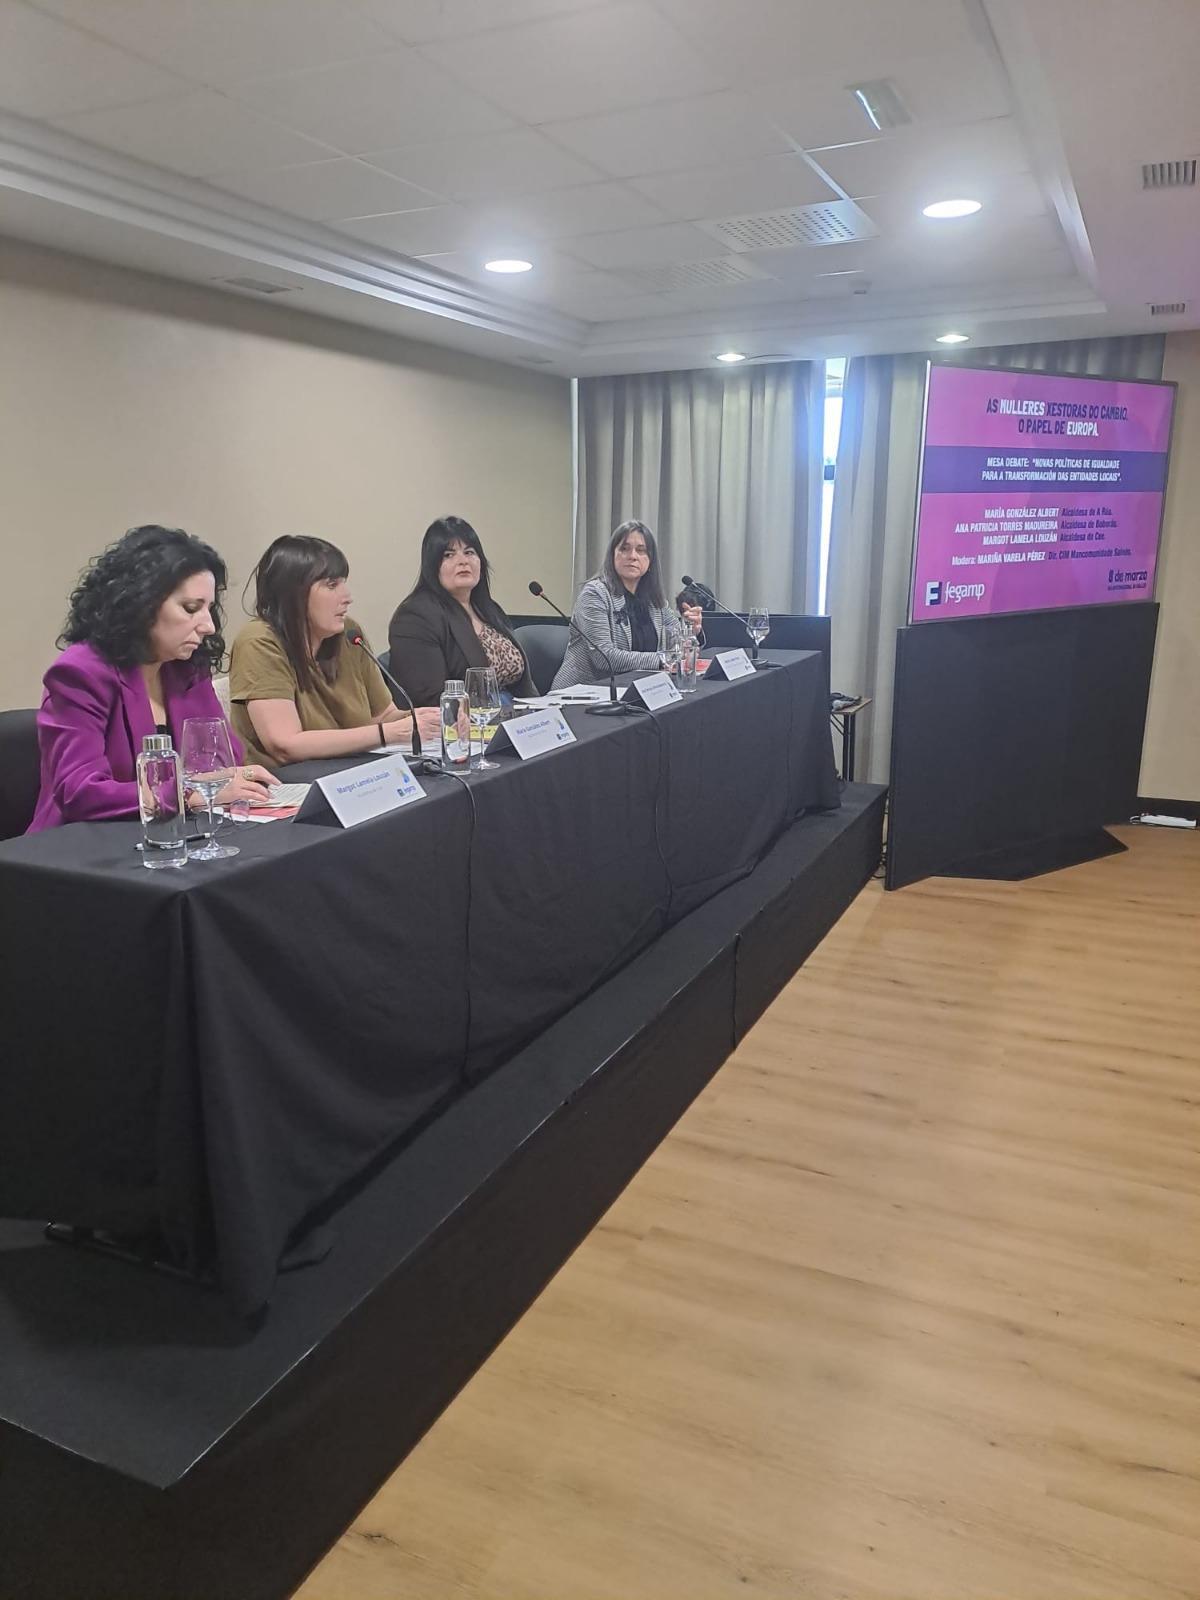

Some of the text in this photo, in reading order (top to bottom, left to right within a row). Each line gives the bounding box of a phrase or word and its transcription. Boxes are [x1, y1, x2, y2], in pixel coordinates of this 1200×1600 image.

[986, 398, 998, 413] AS
[1000, 399, 1045, 416] MULLERES
[1046, 402, 1087, 418] XESTORAS
[1089, 406, 1099, 420] DO
[1018, 418, 1024, 433] O
[1026, 419, 1052, 434] PAPEL
[1054, 421, 1065, 434] DE
[987, 458, 1004, 467] MESA
[1006, 458, 1029, 468] DEBATE:
[1054, 458, 1082, 468] POLÍTICAS
[1083, 460, 1090, 468] DE
[1091, 460, 1120, 469] IGUALDADE
[982, 471, 997, 480] PARA
[999, 471, 1003, 480] A
[1005, 470, 1056, 481] TRANSFORMACIÓN
[1058, 472, 1068, 481] DAS
[1070, 472, 1098, 481] ENTIDADES
[984, 506, 1005, 518] MARÍA
[1006, 506, 1036, 518] GONZÁLEZ
[1037, 508, 1059, 517] ALBERT
[955, 523, 968, 533] ANA
[970, 522, 998, 532] PATRICIA
[1000, 522, 1023, 531] TORRES
[983, 535, 1010, 545] MARGOT
[1010, 534, 1033, 544] LAMELA
[1035, 532, 1058, 543] LOUZÁN
[977, 552, 1002, 564] MARIÑA
[1004, 552, 1026, 562] VARELA
[1027, 550, 1045, 561] PÉREZ
[1115, 570, 1124, 582] de
[1125, 571, 1147, 581] marzo
[945, 581, 985, 603] fegamp
